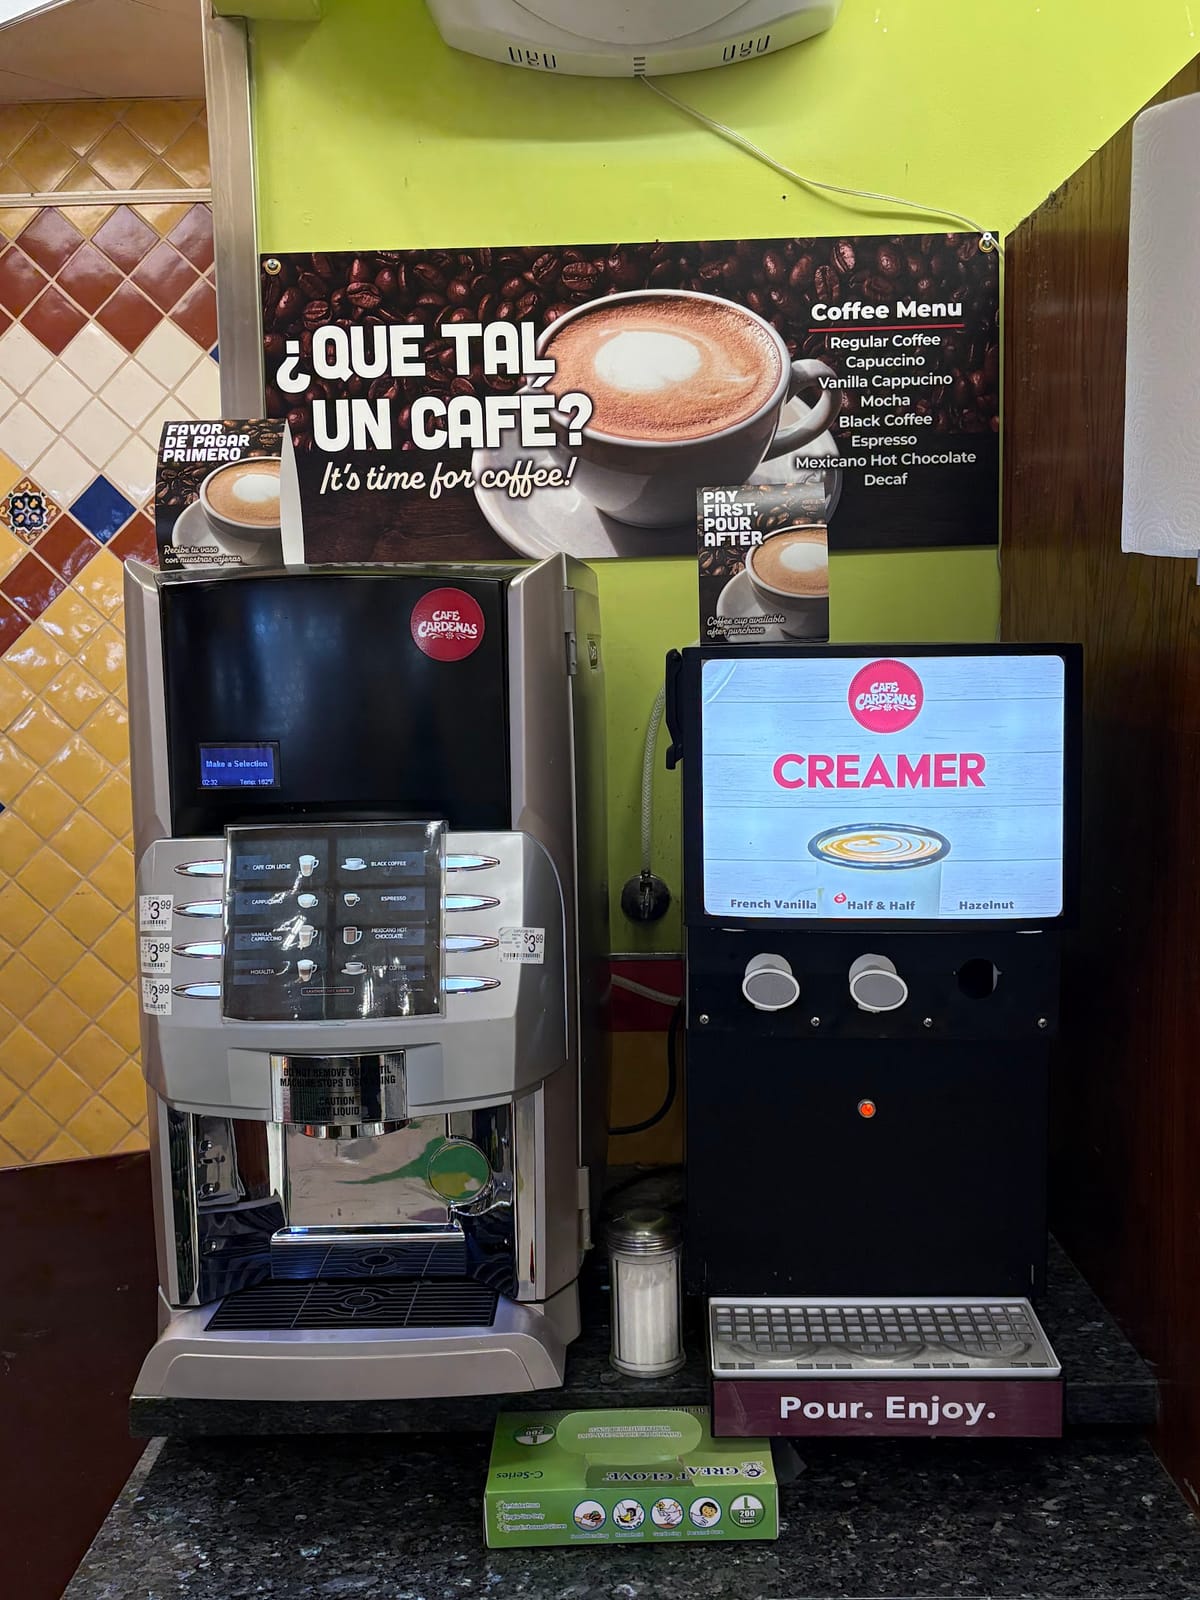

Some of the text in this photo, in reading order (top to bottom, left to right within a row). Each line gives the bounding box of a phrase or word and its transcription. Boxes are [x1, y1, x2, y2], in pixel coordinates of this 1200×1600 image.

[811, 301, 963, 321] Coffee Menu
[831, 334, 941, 351] Regular Coffee
[276, 321, 555, 393] ¿QUE TAL
[846, 354, 926, 370] Capuccino
[818, 373, 953, 390] Vanilla Cappucino
[861, 394, 911, 408] Mocha
[312, 376, 593, 452] UN CAFÉ?
[839, 413, 933, 428] Black Coffee
[167, 423, 223, 435] FAVOR
[164, 434, 250, 448] DE PAGAR
[851, 436, 918, 449] Espresso
[163, 447, 241, 462] PRIMERO
[796, 451, 976, 469] Mexicano Hot Chocolate
[320, 457, 579, 499] It's time for coffee!
[864, 472, 908, 486] Decaf
[703, 490, 738, 504] PAY
[703, 502, 758, 517] FIRST,
[704, 517, 752, 532] POUR
[704, 531, 764, 547] AFTER
[164, 545, 190, 555] Recibe
[707, 614, 786, 627] Coffee cup available
[418, 621, 478, 637] CARDENAS
[707, 626, 765, 638] after purchase
[855, 693, 917, 711] CARDENAS
[206, 760, 226, 768] Make
[233, 760, 268, 768] Selection
[772, 752, 987, 790] CREAMER
[730, 898, 817, 909] French Vanilla
[847, 900, 916, 911] Half & Half
[959, 900, 1015, 910] Hazelnut
[332, 1106, 360, 1117] LIQUID
[780, 1395, 997, 1426] Pour. Enjoy.
[496, 1469, 544, 1480] C-Series
[743, 1497, 750, 1509] L
